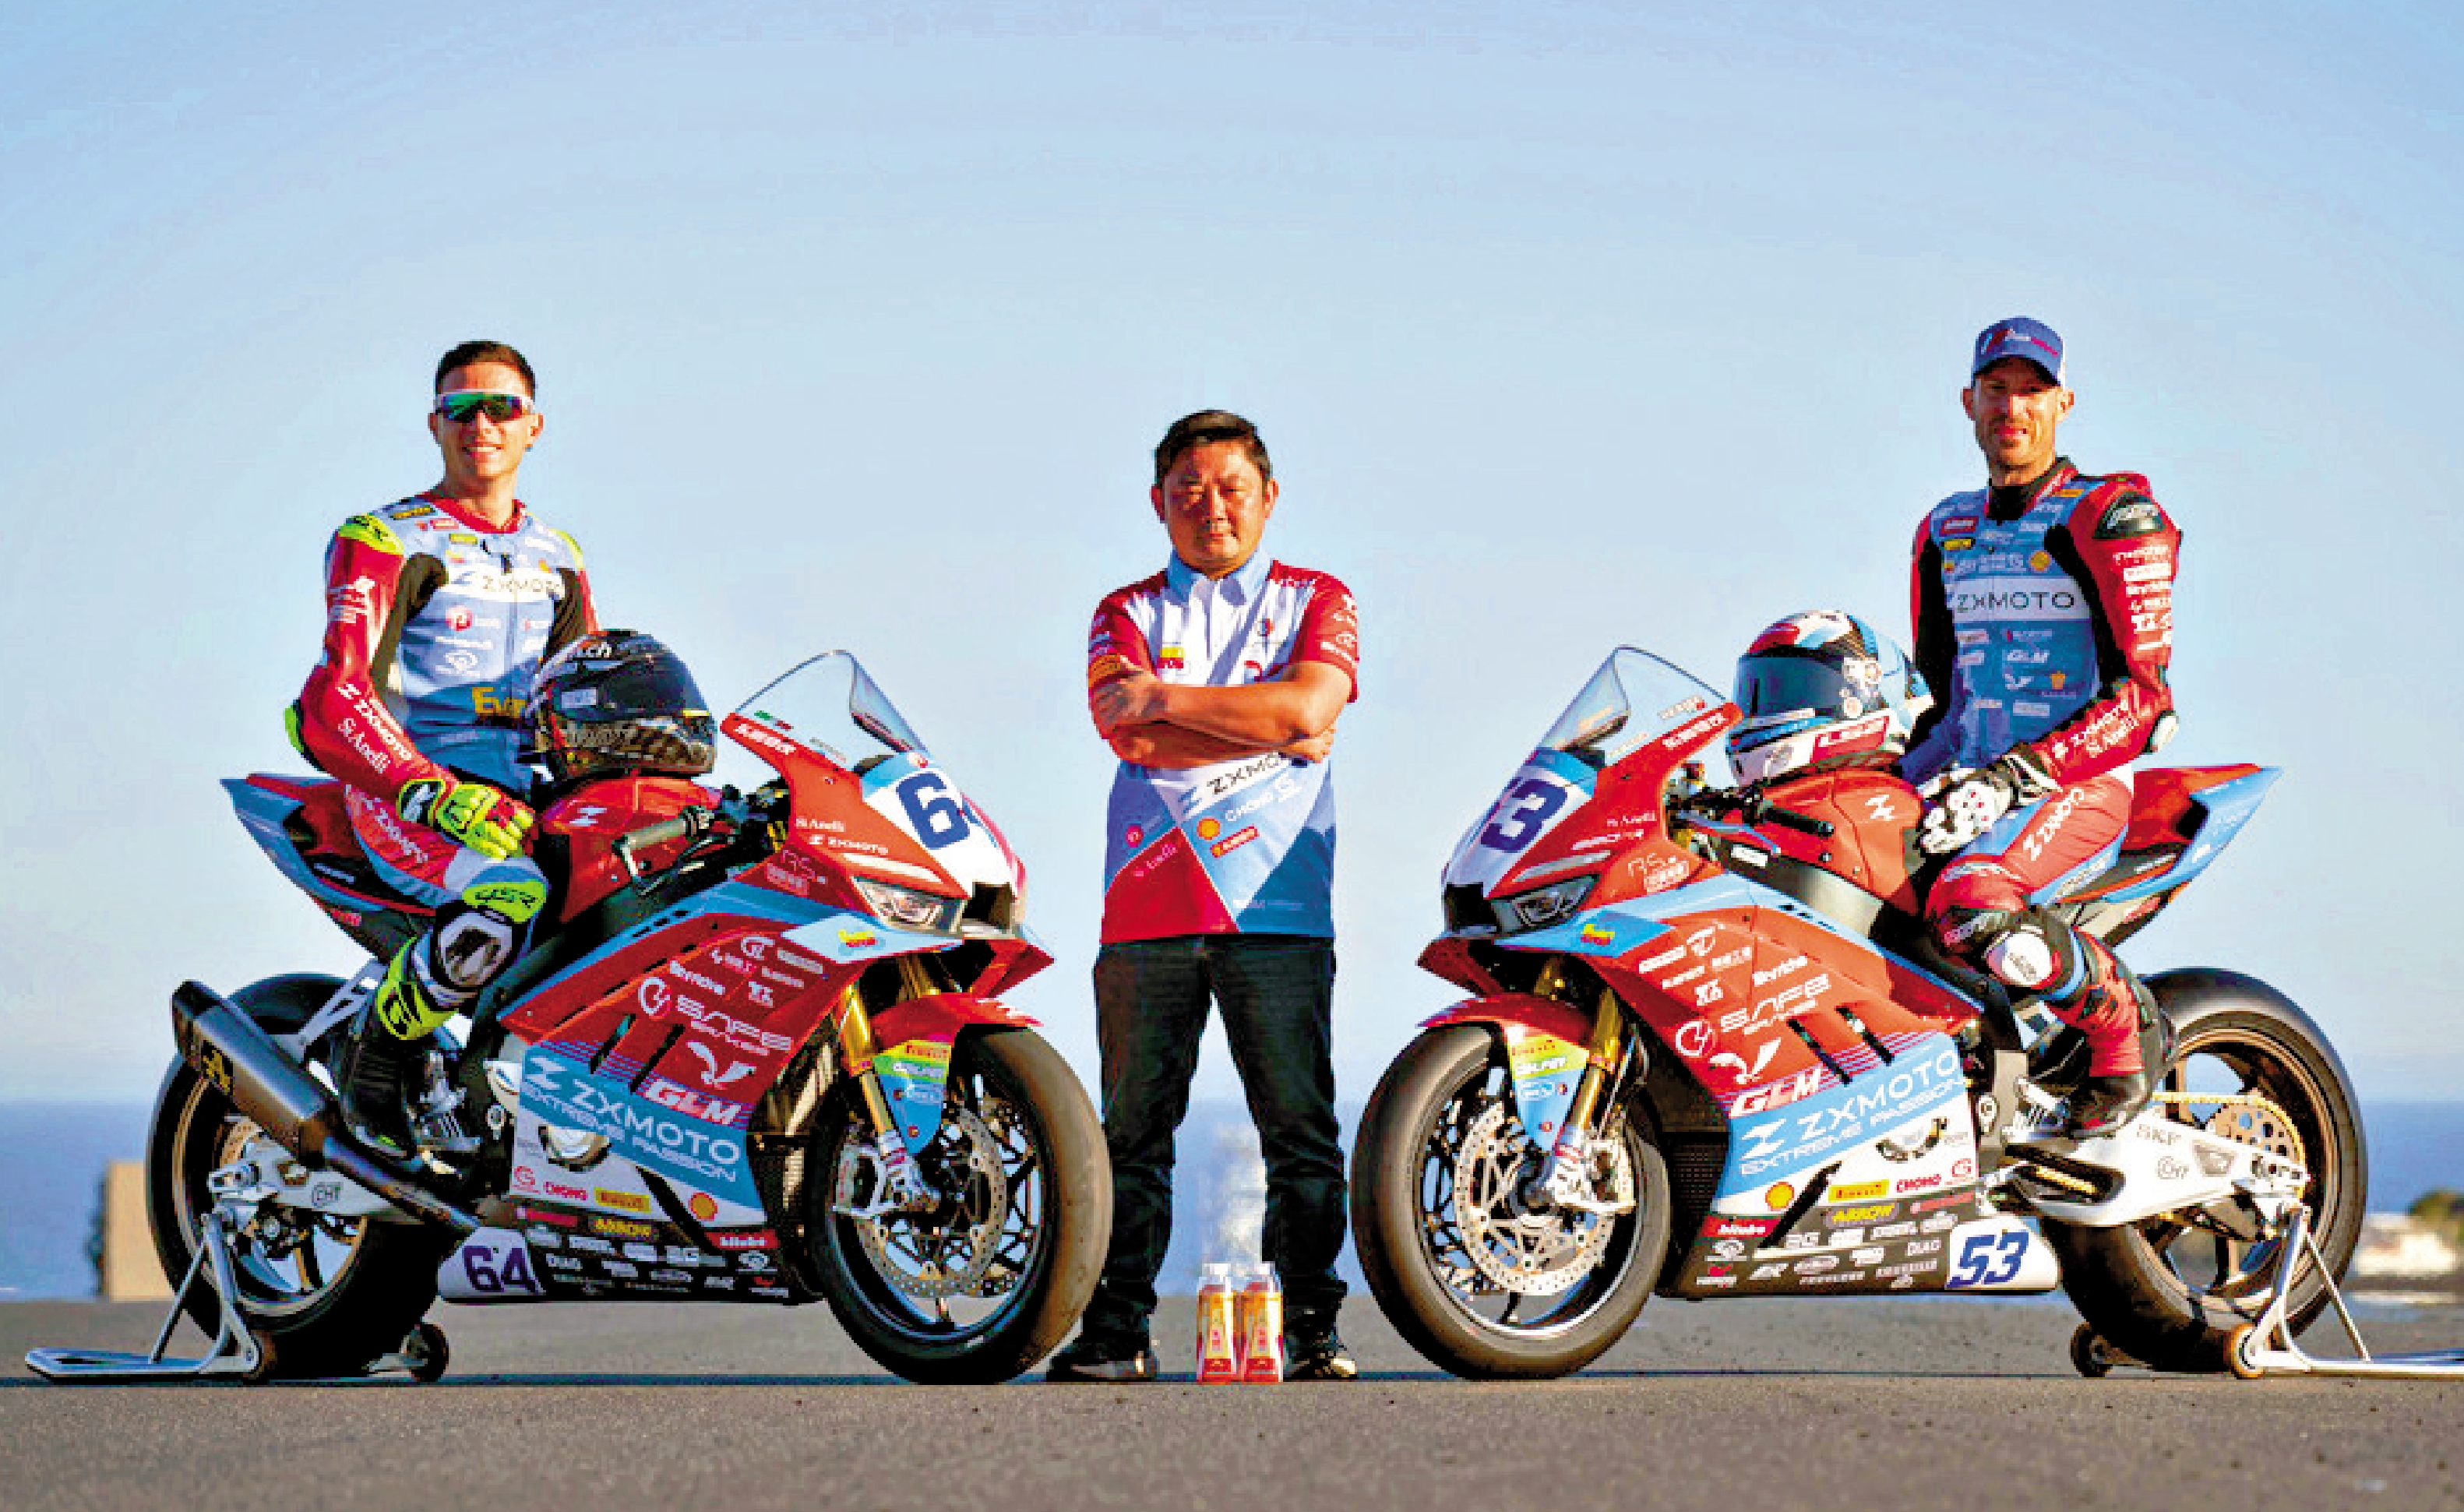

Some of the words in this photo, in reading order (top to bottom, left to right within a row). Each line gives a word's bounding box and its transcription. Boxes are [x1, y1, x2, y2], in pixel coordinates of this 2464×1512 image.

[1957, 591, 2076, 612] ZXMOTO
[1207, 752, 1290, 795] ZXMO
[644, 1078, 742, 1126] GLM
[1729, 1067, 1822, 1119] GLM
[1797, 1049, 1958, 1141] ZXMOTO
[521, 1082, 626, 1143] EXTREME
[631, 1134, 738, 1183] PASSION
[570, 1079, 741, 1165] ZXMOTO
[1740, 1122, 1863, 1176] EXTREME
[1870, 1076, 1965, 1126] PASSION
[463, 1244, 542, 1295] 64
[1946, 1232, 2030, 1288] 53
